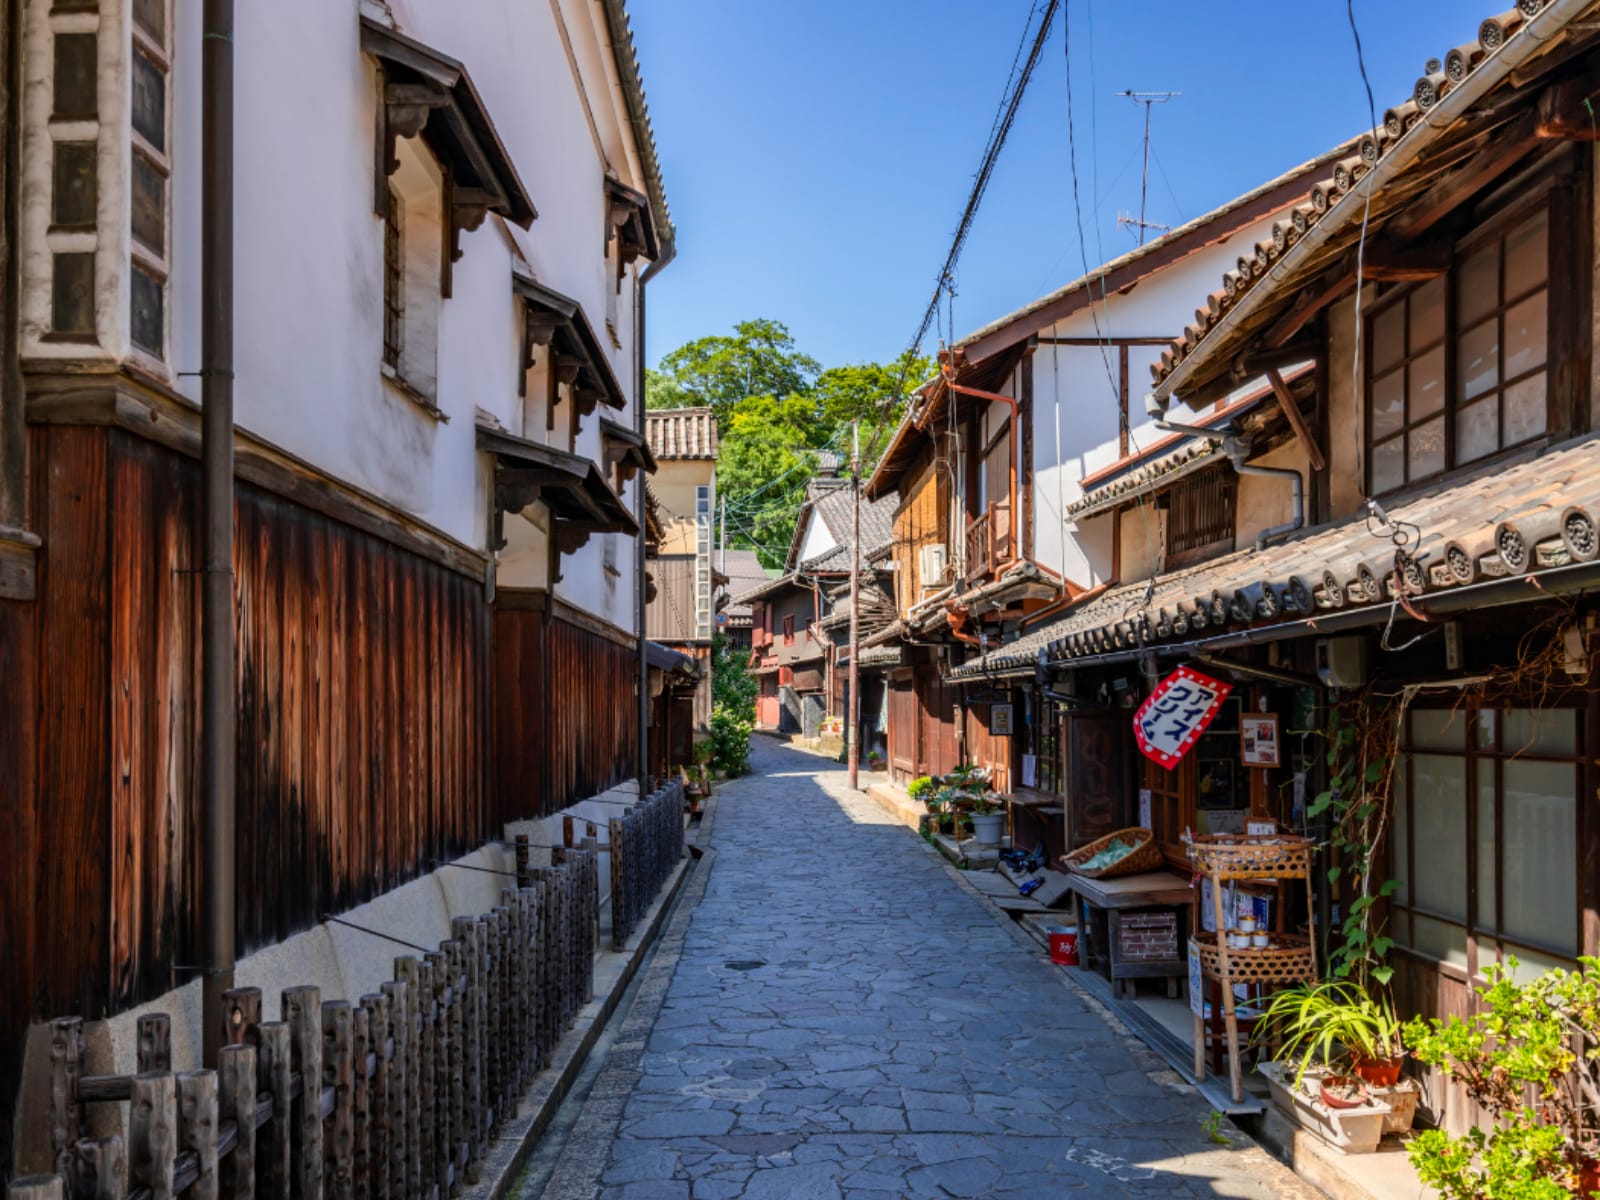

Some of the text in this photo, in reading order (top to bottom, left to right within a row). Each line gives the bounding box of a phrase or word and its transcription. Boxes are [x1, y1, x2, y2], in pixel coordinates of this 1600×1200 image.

[1142, 685, 1192, 741] クリーム
[1164, 688, 1214, 741] アイス
